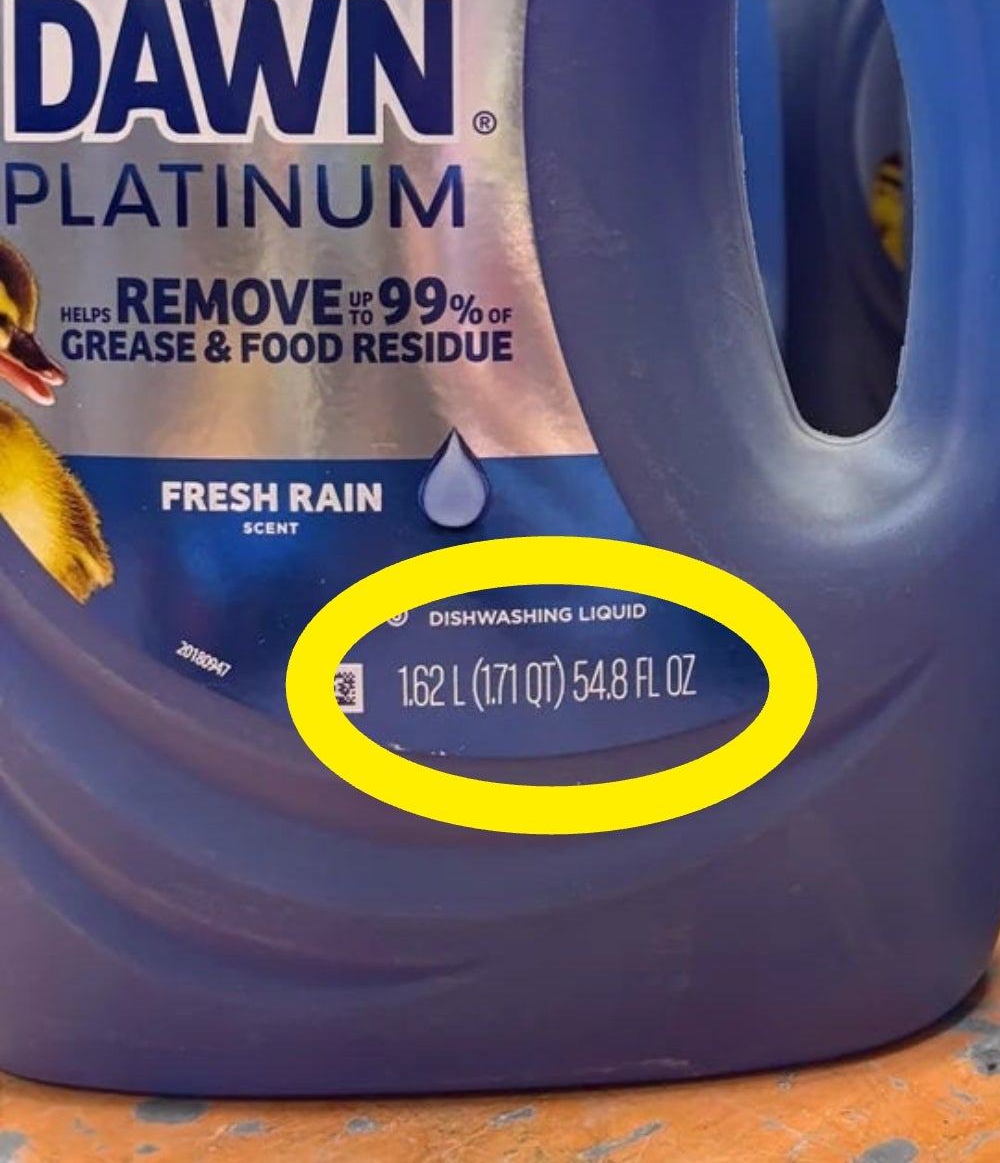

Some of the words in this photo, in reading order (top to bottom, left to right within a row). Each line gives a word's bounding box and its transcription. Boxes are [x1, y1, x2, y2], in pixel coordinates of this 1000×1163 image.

[5, 162, 466, 229] PLATINUM
[116, 277, 343, 326] REMOVE
[349, 291, 373, 308] UP
[378, 277, 483, 326] 99%
[60, 306, 111, 324] HELPS
[349, 309, 373, 325] TO
[488, 307, 512, 324] OF
[61, 329, 196, 362] GREASE
[204, 330, 232, 363] &
[241, 332, 343, 363] FOOD
[352, 330, 513, 363] RESIDUE
[161, 482, 279, 512] FRESH
[289, 483, 382, 513] RAIN
[242, 522, 299, 535] SCENT
[429, 607, 572, 627] DISHWASHING
[578, 603, 647, 622] LIQUID
[397, 664, 446, 707] 1.62
[453, 665, 466, 707] L
[472, 657, 518, 713] (1.71
[525, 654, 565, 710] QT)
[572, 658, 628, 702] 54.8
[635, 656, 661, 699] FL
[665, 653, 697, 696] OZ
